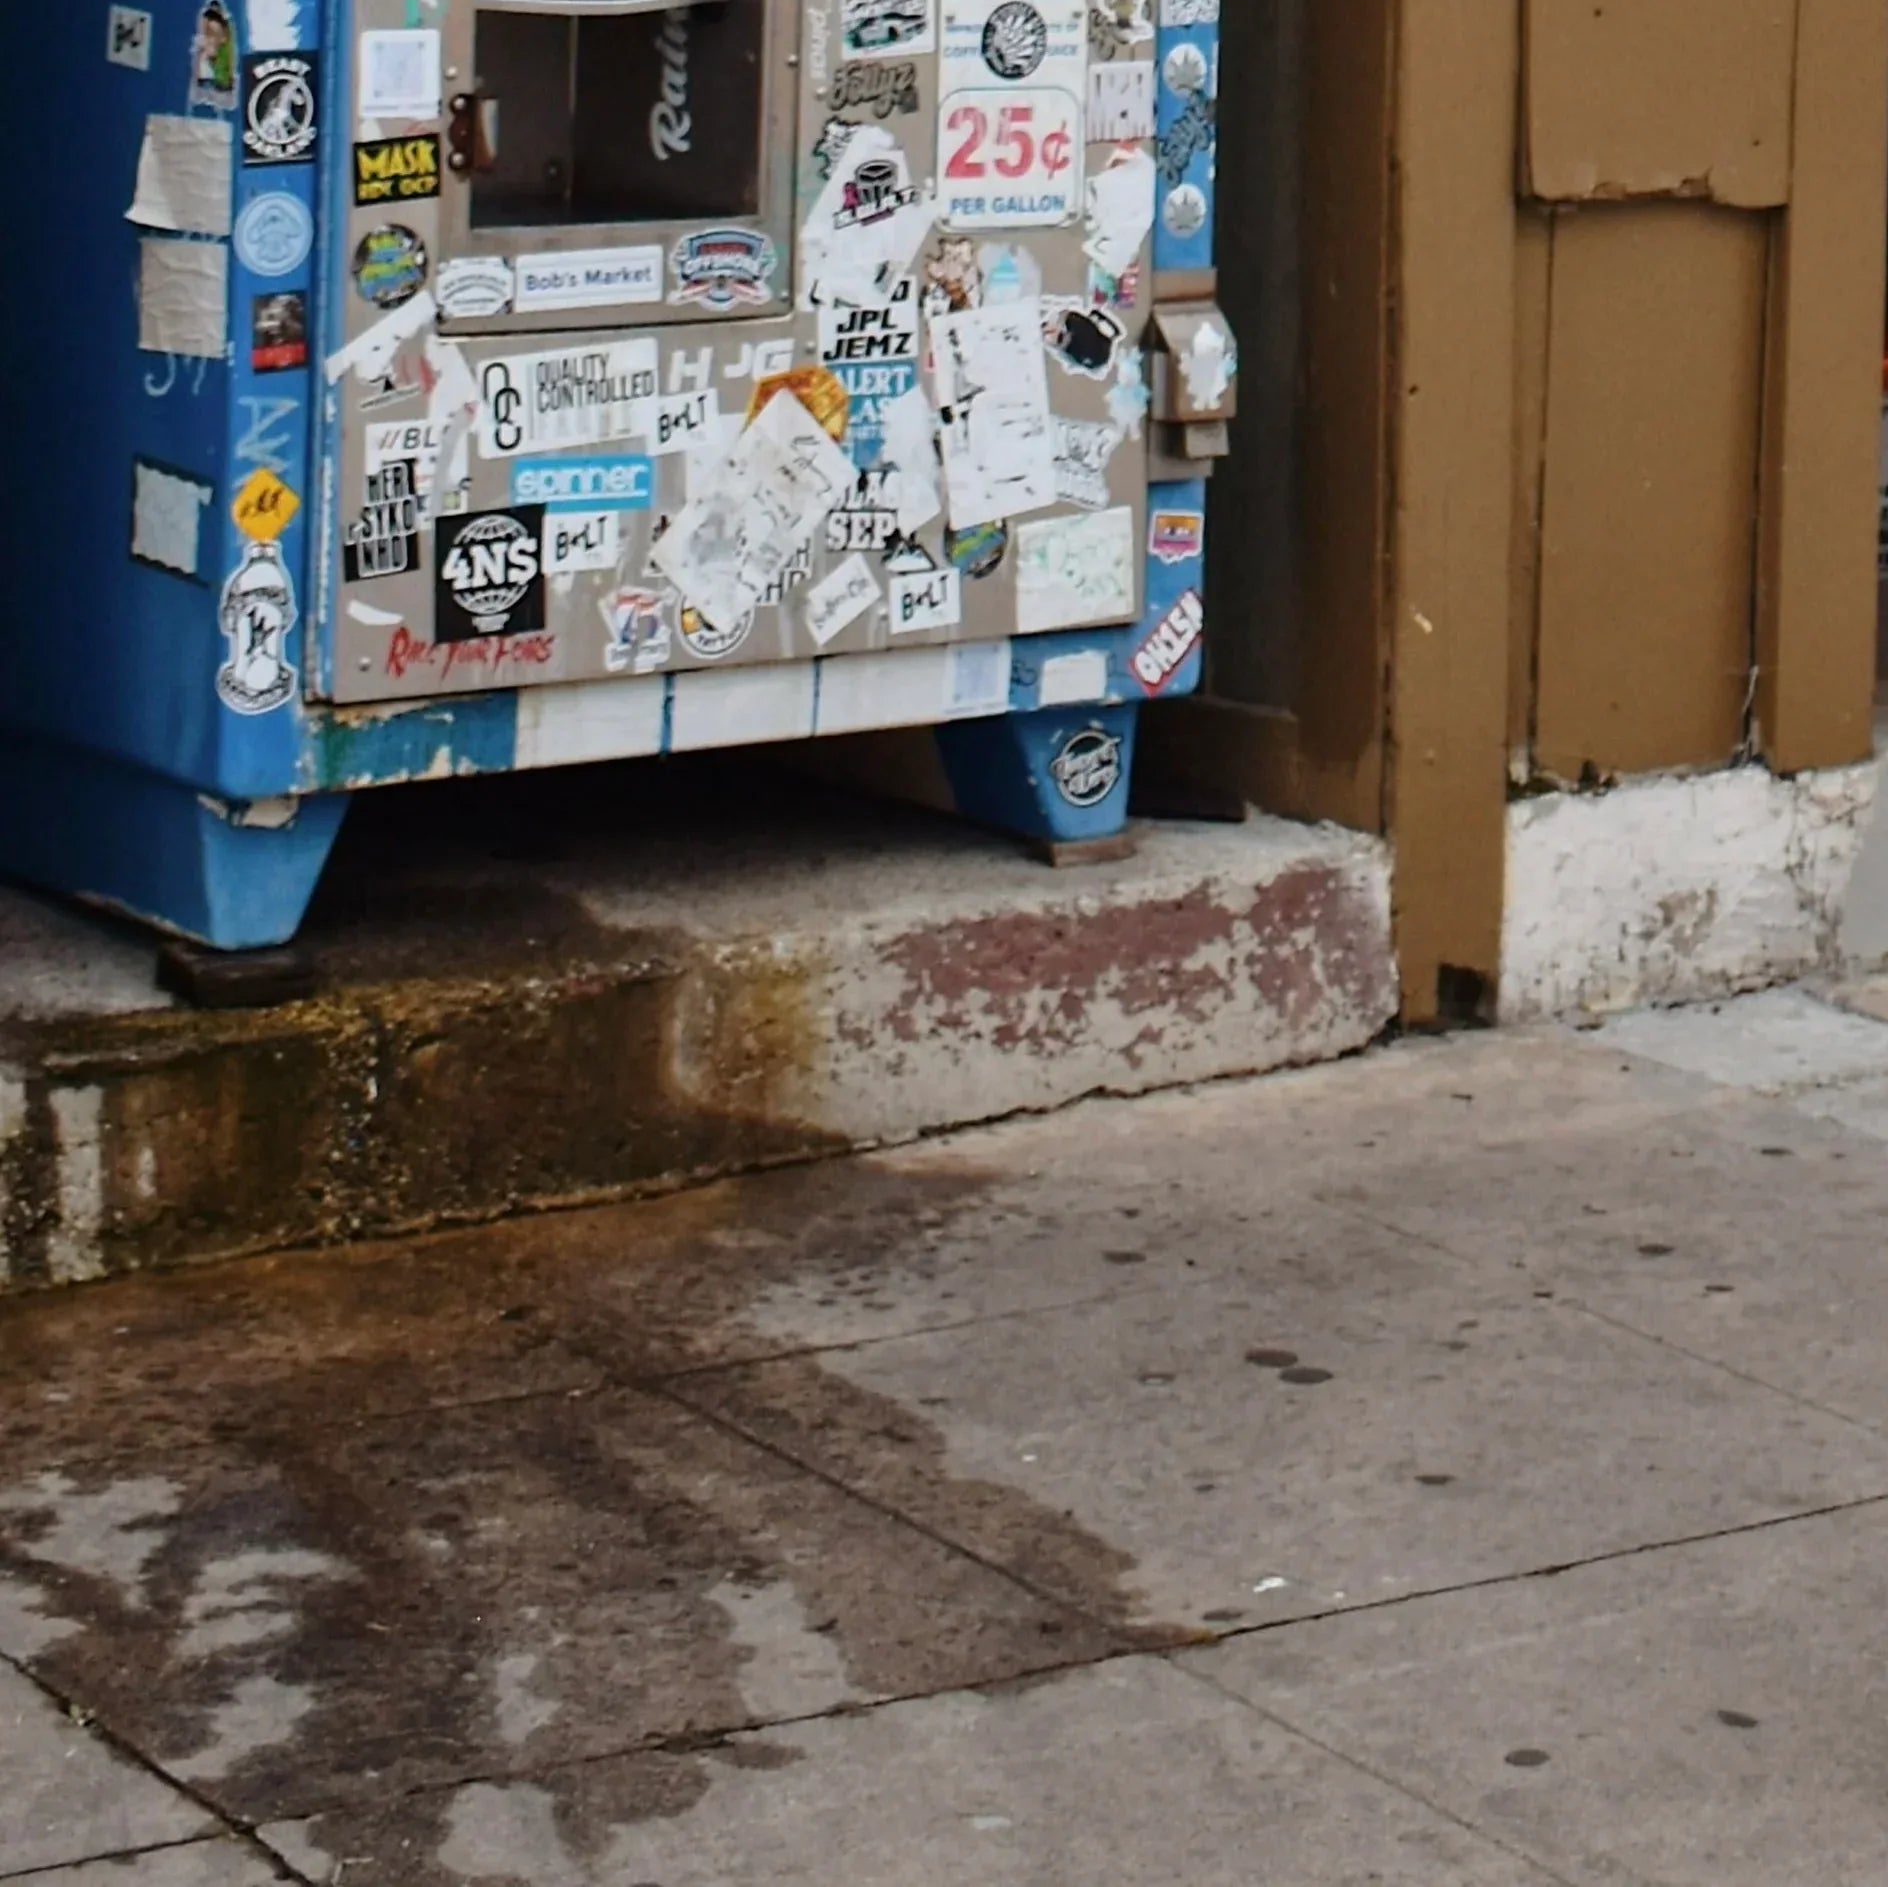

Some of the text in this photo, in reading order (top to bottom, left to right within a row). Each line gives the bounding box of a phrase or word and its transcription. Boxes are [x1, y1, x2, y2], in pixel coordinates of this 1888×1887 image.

[945, 106, 1071, 181] 25¢
[357, 140, 437, 180] MASK
[951, 194, 1066, 215] PER GALLON
[525, 265, 653, 292] Bob's Market
[836, 309, 897, 334] JPL
[823, 332, 913, 361] JEMZ
[537, 353, 610, 385] QUALITY
[537, 370, 655, 414] CONTROLLED
[441, 538, 539, 592] 4NS
